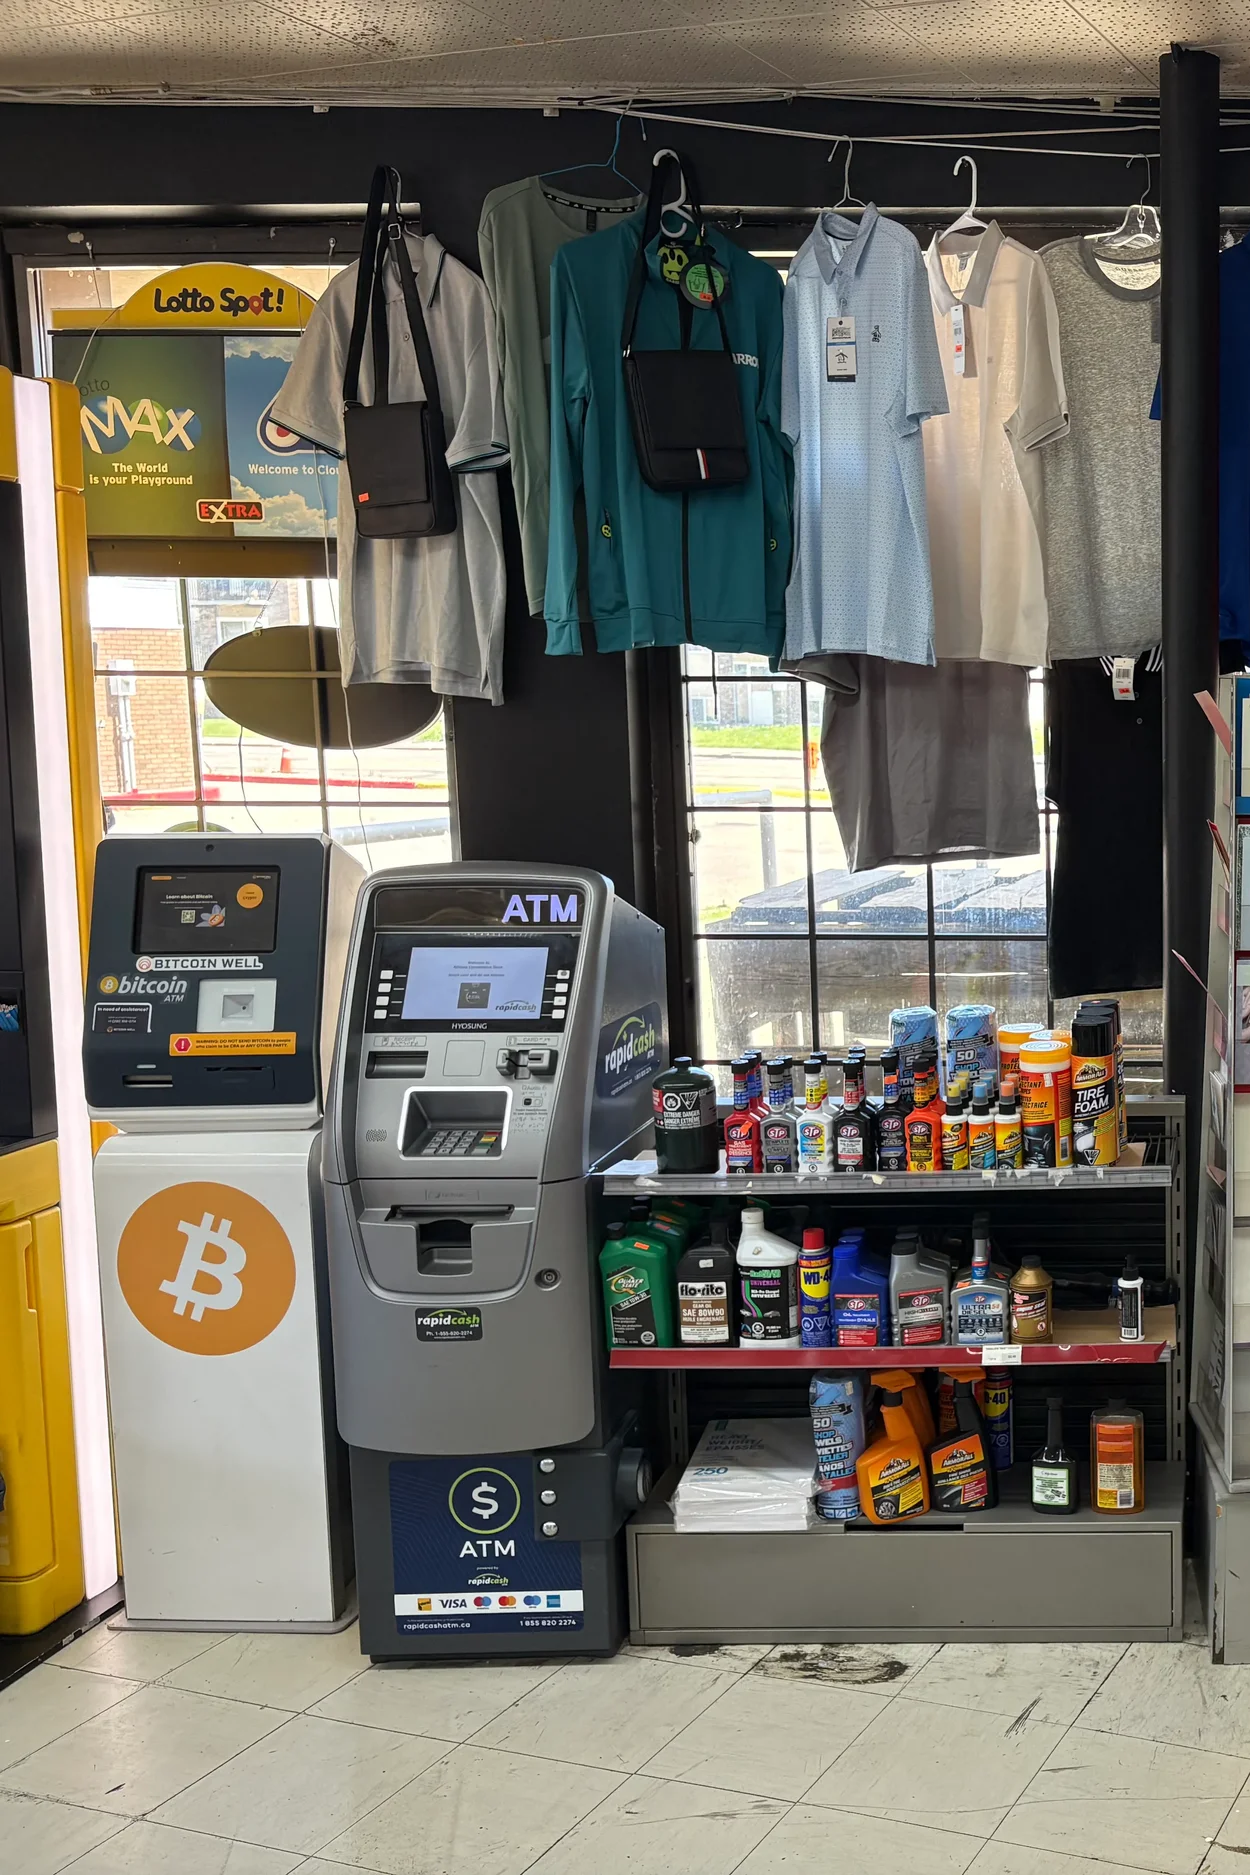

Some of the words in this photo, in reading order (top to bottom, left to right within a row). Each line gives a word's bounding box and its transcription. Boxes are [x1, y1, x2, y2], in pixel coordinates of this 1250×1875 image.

[154, 287, 215, 314] Lotto
[219, 288, 284, 317] Spot!
[80, 377, 110, 397] otto
[80, 395, 195, 454] MAX
[112, 463, 133, 473] The
[135, 463, 168, 473] World
[248, 464, 299, 475] Welcome
[302, 464, 315, 475] to
[318, 464, 339, 475] Clou
[89, 474, 100, 485] is
[102, 476, 127, 487] your
[131, 475, 193, 487] Playground
[200, 501, 262, 524] EXTRA
[502, 894, 578, 923] ATM
[154, 958, 217, 969] BITCOIN
[221, 957, 261, 968] WELL
[118, 976, 188, 994] bitcoin
[163, 995, 185, 1003] ATM
[495, 1001, 537, 1012] rapidcash
[605, 1023, 655, 1074] rapidcash
[956, 1050, 976, 1061] 50
[955, 1063, 979, 1071] SHOP
[1077, 1085, 1106, 1102] TIRE
[1074, 1095, 1109, 1114] FOAM
[883, 1120, 900, 1130] STP
[768, 1128, 786, 1138] STP
[803, 1128, 821, 1137] STP
[841, 1128, 859, 1137] STP
[803, 1269, 830, 1285] WD-4
[620, 1299, 630, 1308] SAE
[848, 1300, 865, 1310] STP
[913, 1296, 930, 1307] STP
[682, 1309, 697, 1317] SAE
[698, 1308, 725, 1317] 80W90
[417, 1313, 480, 1328] rapidcash
[813, 1418, 831, 1427] 50
[693, 1467, 729, 1476] 250
[459, 1539, 516, 1558] ATM
[468, 1575, 509, 1586] rapidcash
[438, 1599, 468, 1609] VISA
[403, 1622, 471, 1631] rapidcashatm.ca
